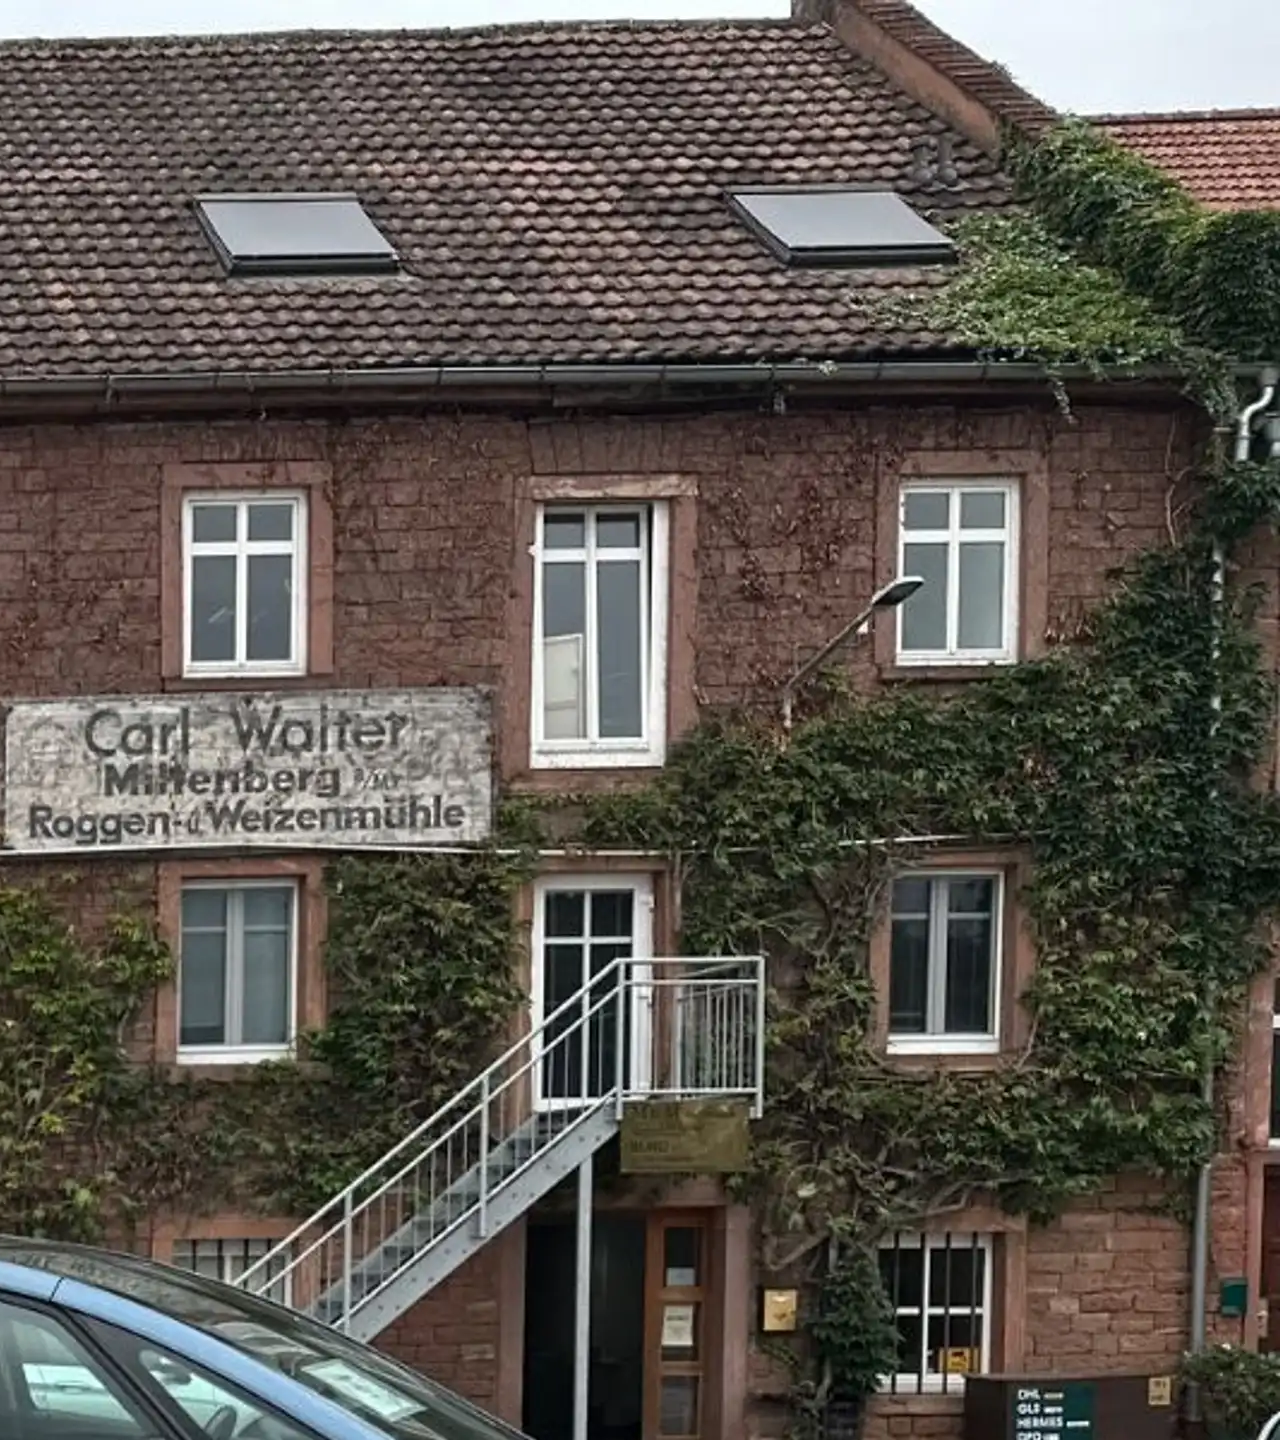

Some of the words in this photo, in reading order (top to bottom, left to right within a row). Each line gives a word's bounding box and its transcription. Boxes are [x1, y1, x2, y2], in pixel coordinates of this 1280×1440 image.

[84, 706, 190, 756] Carl
[230, 699, 408, 754] Walter
[206, 794, 466, 834] Weizenmühle
[1016, 1403, 1041, 1415] GLS
